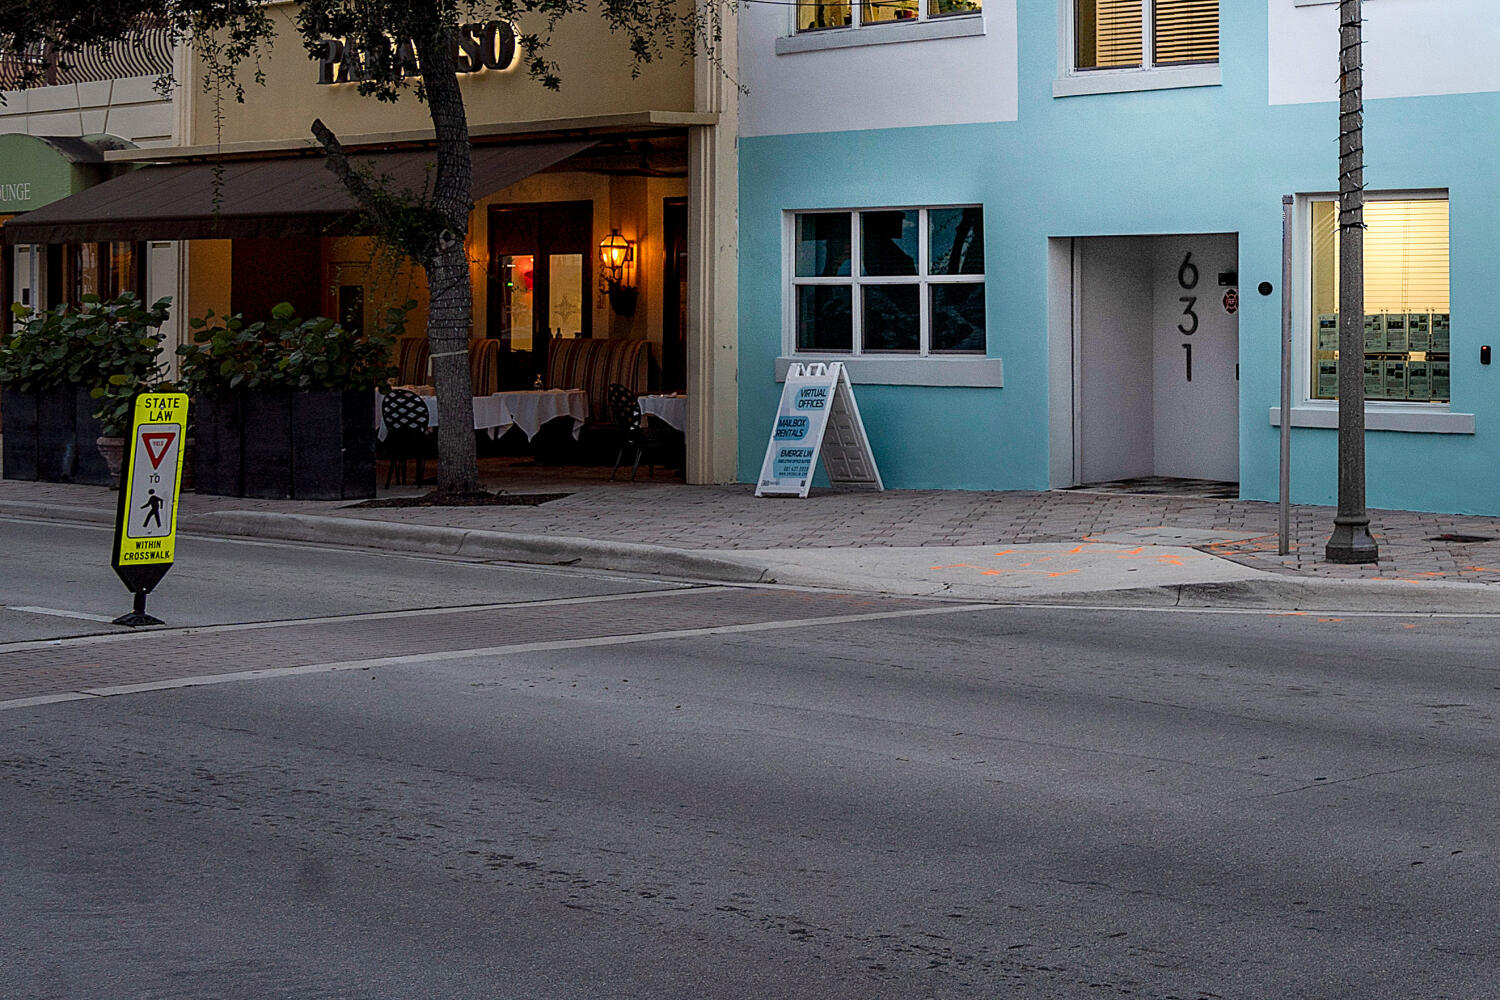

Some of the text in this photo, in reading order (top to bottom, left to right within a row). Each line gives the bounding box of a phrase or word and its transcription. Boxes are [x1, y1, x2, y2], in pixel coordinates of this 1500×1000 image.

[0, 182, 31, 201] UNGE
[800, 388, 826, 397] VIRTUAL
[145, 397, 180, 409] STATE
[798, 399, 824, 408] OFFICES
[149, 411, 173, 422] LAW
[777, 419, 806, 427] MAILBOX
[775, 428, 804, 438] RENTALS
[149, 475, 160, 484] TO
[135, 541, 161, 550] WITHIN
[124, 550, 171, 561] CROSSWALK
